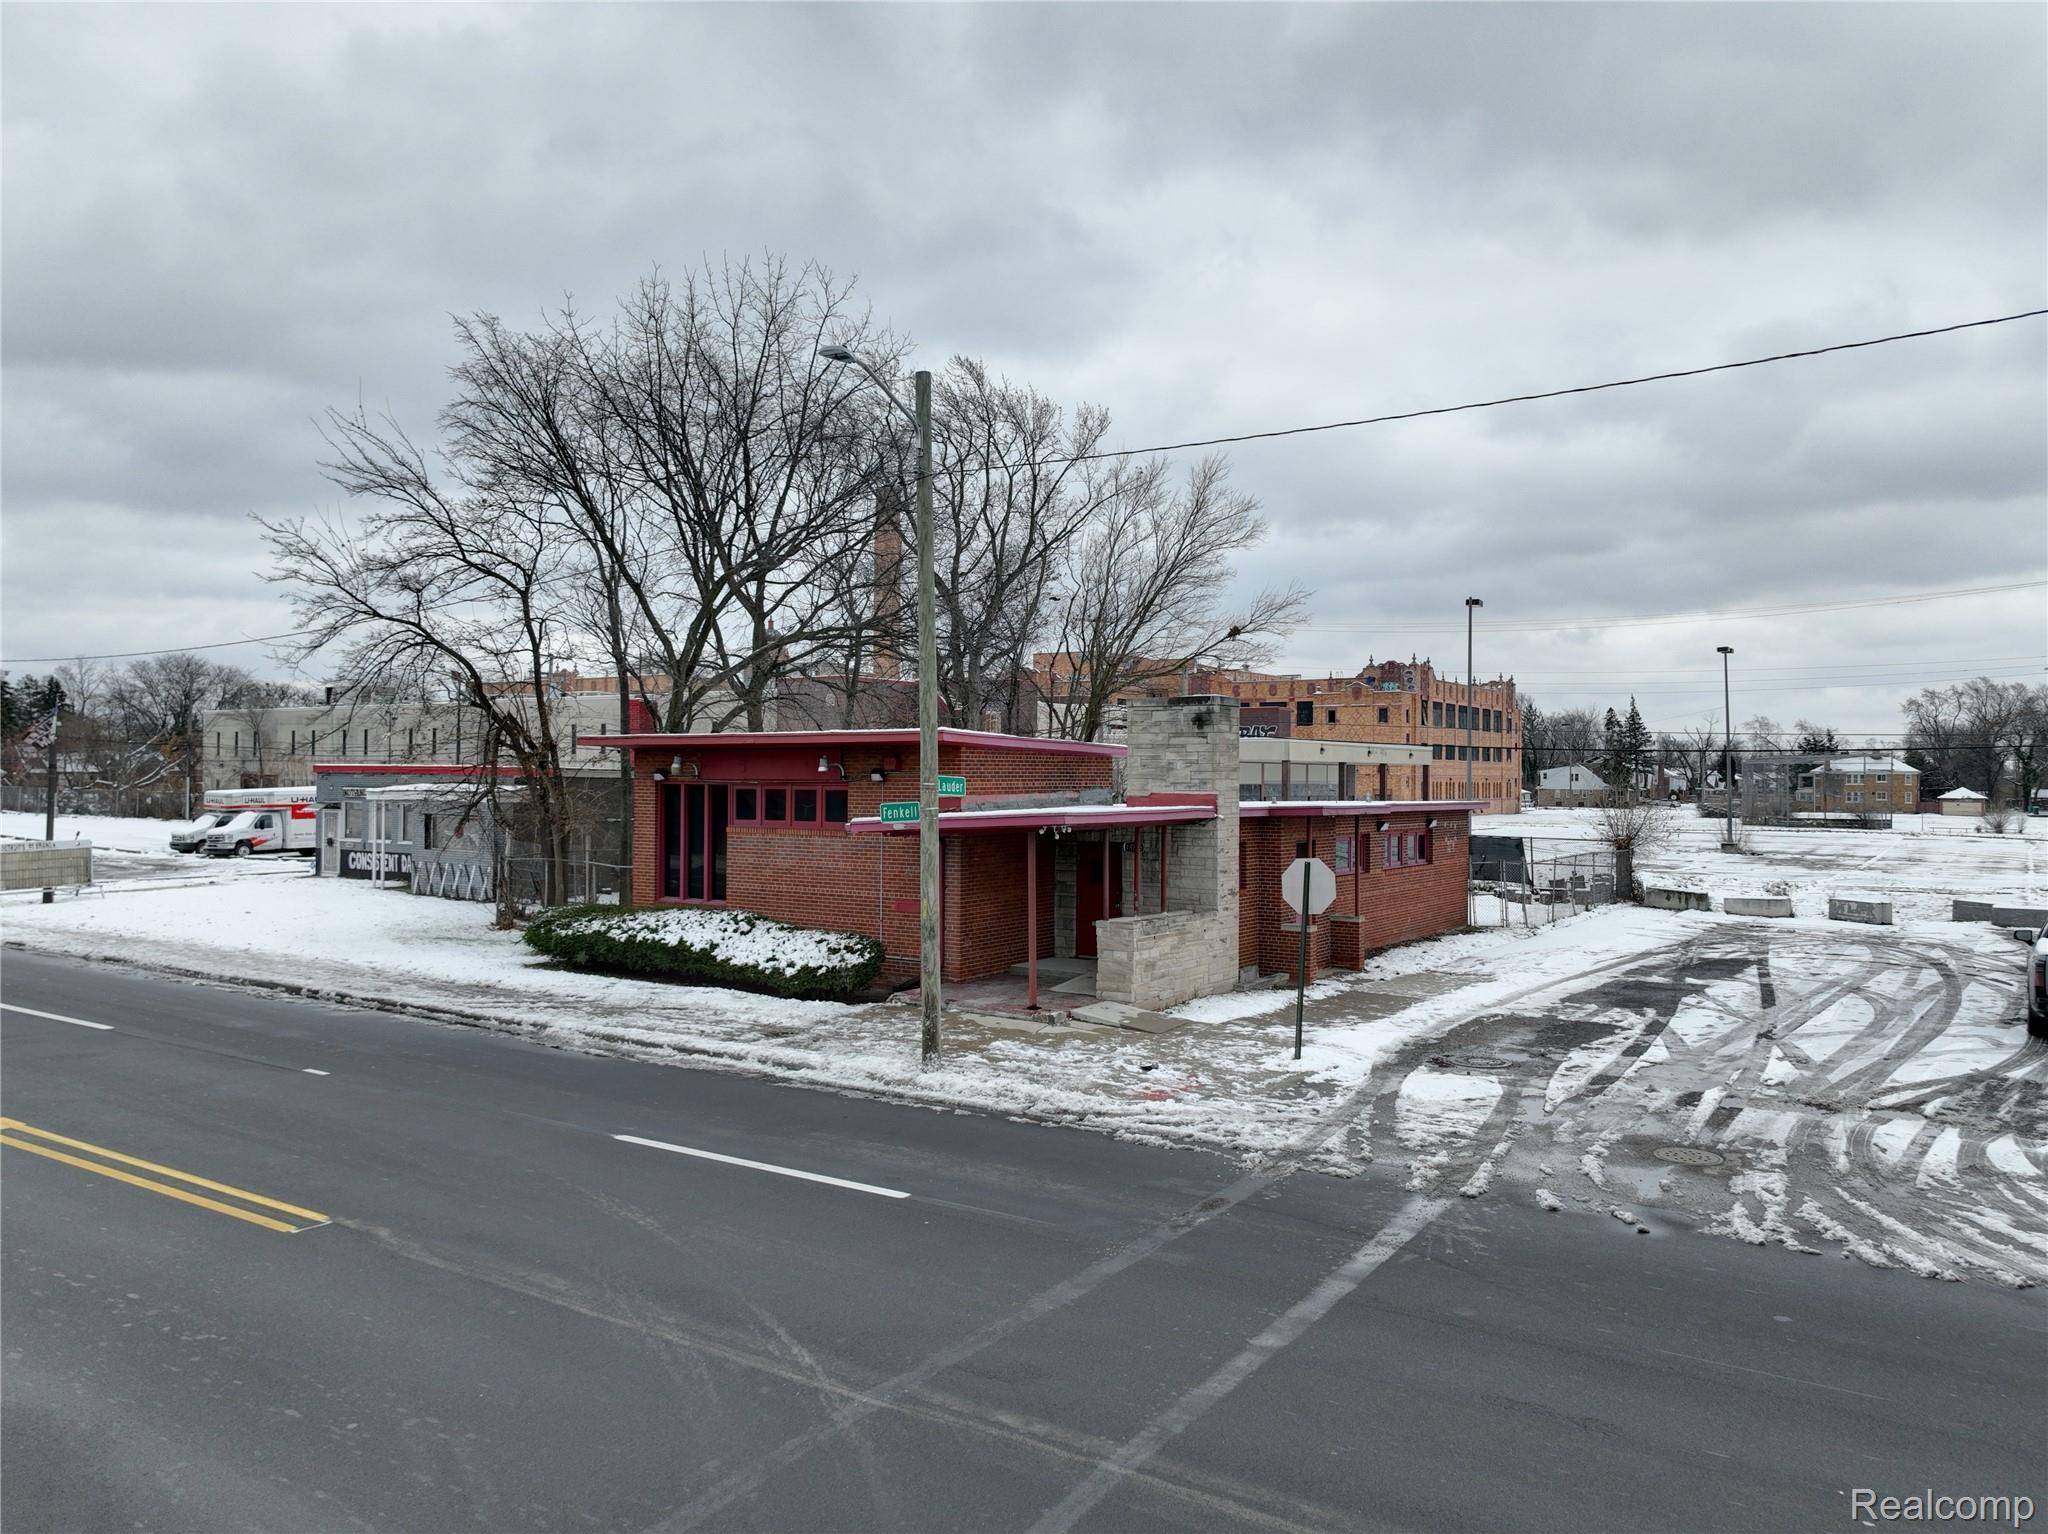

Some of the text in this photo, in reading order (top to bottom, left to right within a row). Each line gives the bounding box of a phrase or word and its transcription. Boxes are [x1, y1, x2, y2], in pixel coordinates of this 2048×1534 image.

[938, 779, 964, 793] Lauder
[883, 806, 918, 819] Fenkell
[348, 851, 399, 872] CONSSENT
